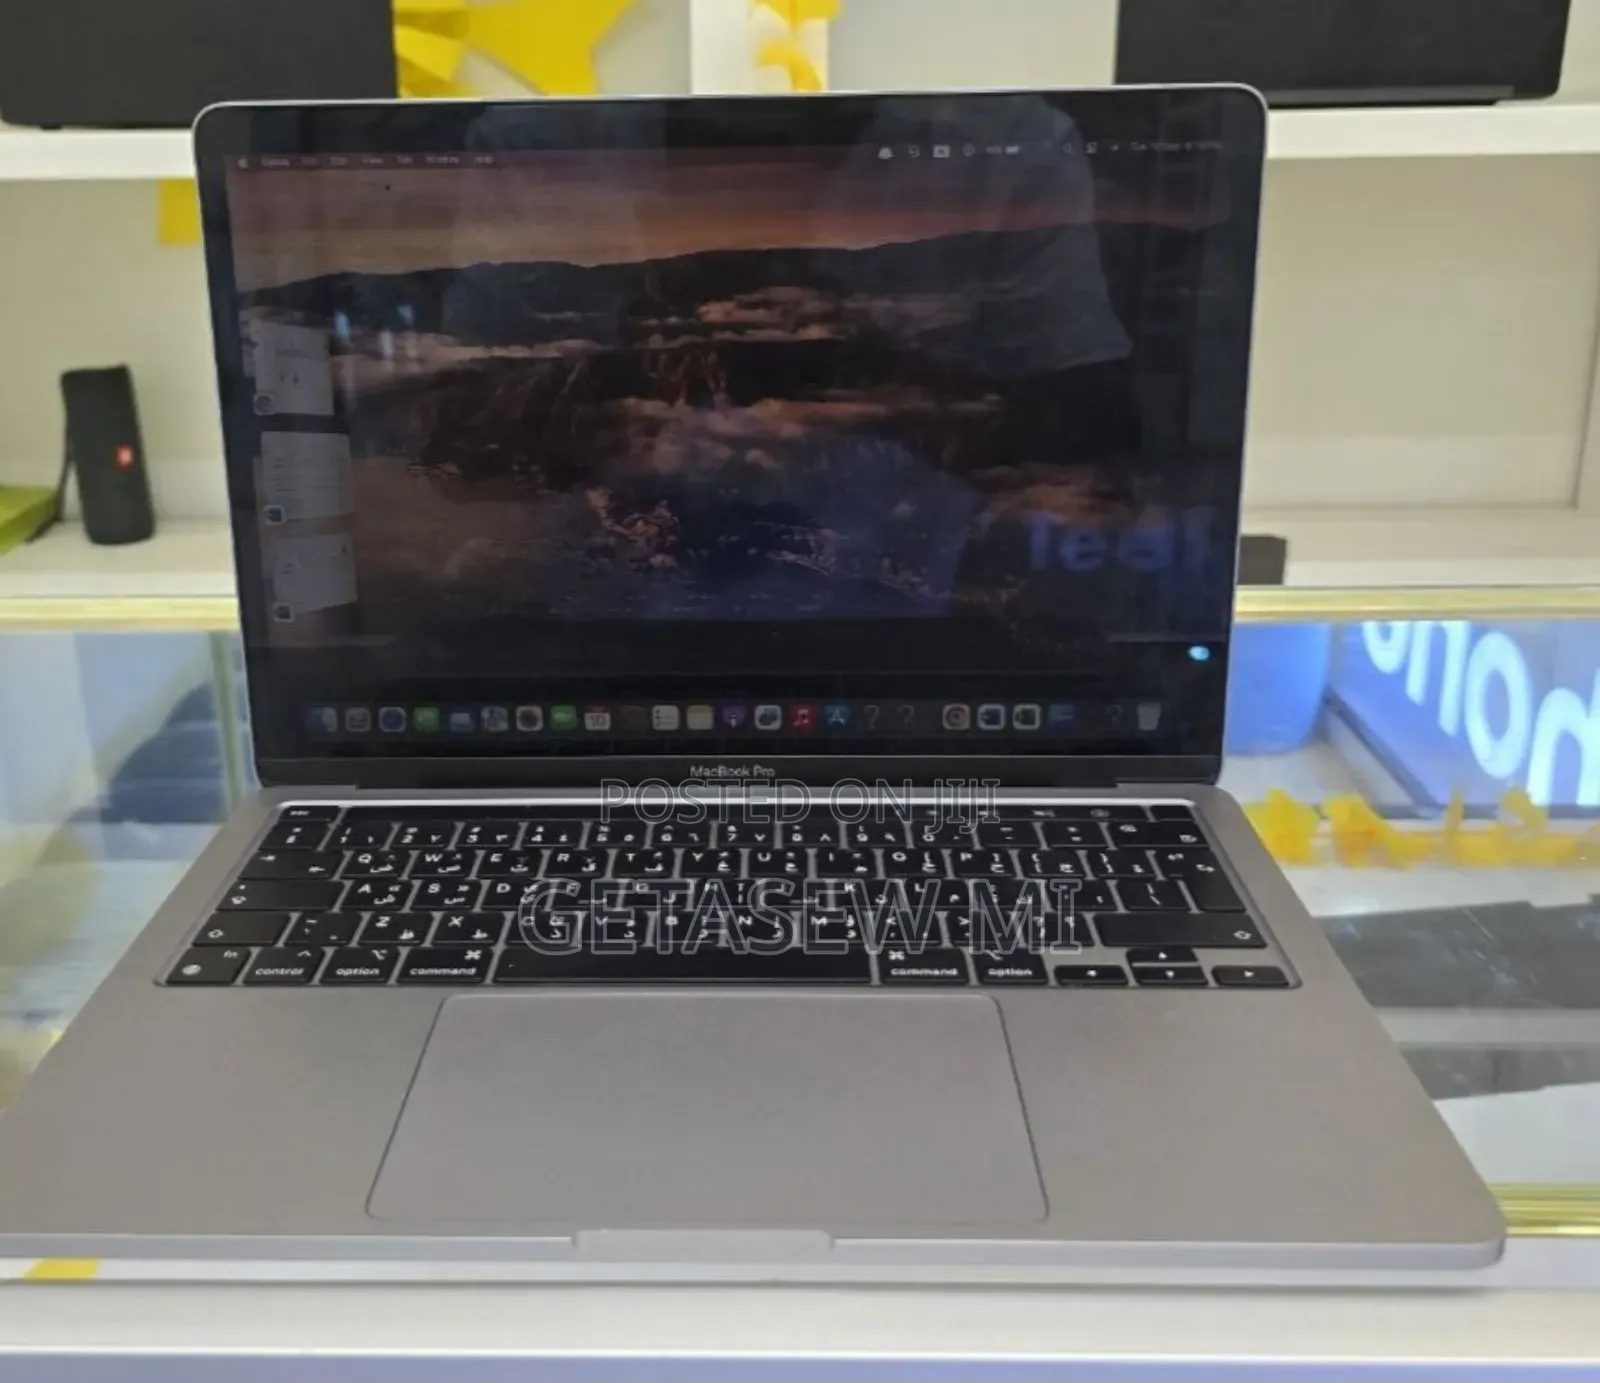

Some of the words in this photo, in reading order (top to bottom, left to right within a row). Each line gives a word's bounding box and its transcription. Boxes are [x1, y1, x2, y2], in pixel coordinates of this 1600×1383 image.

[690, 765, 750, 777] MacBook
[753, 765, 776, 777] Pro
[357, 853, 373, 865] Q
[424, 853, 444, 863] W
[489, 853, 503, 863] E
[556, 853, 571, 863] R
[625, 852, 637, 862] T
[692, 852, 704, 862] Y
[757, 852, 772, 863] U
[891, 851, 908, 863] O
[959, 852, 973, 862] P
[357, 883, 372, 894] A
[427, 883, 441, 894] S
[495, 883, 512, 894] D
[375, 915, 392, 928] Z
[447, 915, 465, 928] X
[738, 915, 752, 927] N
[811, 915, 829, 926] M
[255, 967, 305, 976] control
[336, 967, 380, 978] option
[410, 967, 477, 976] command
[891, 967, 959, 977] command
[988, 967, 1033, 978] option
